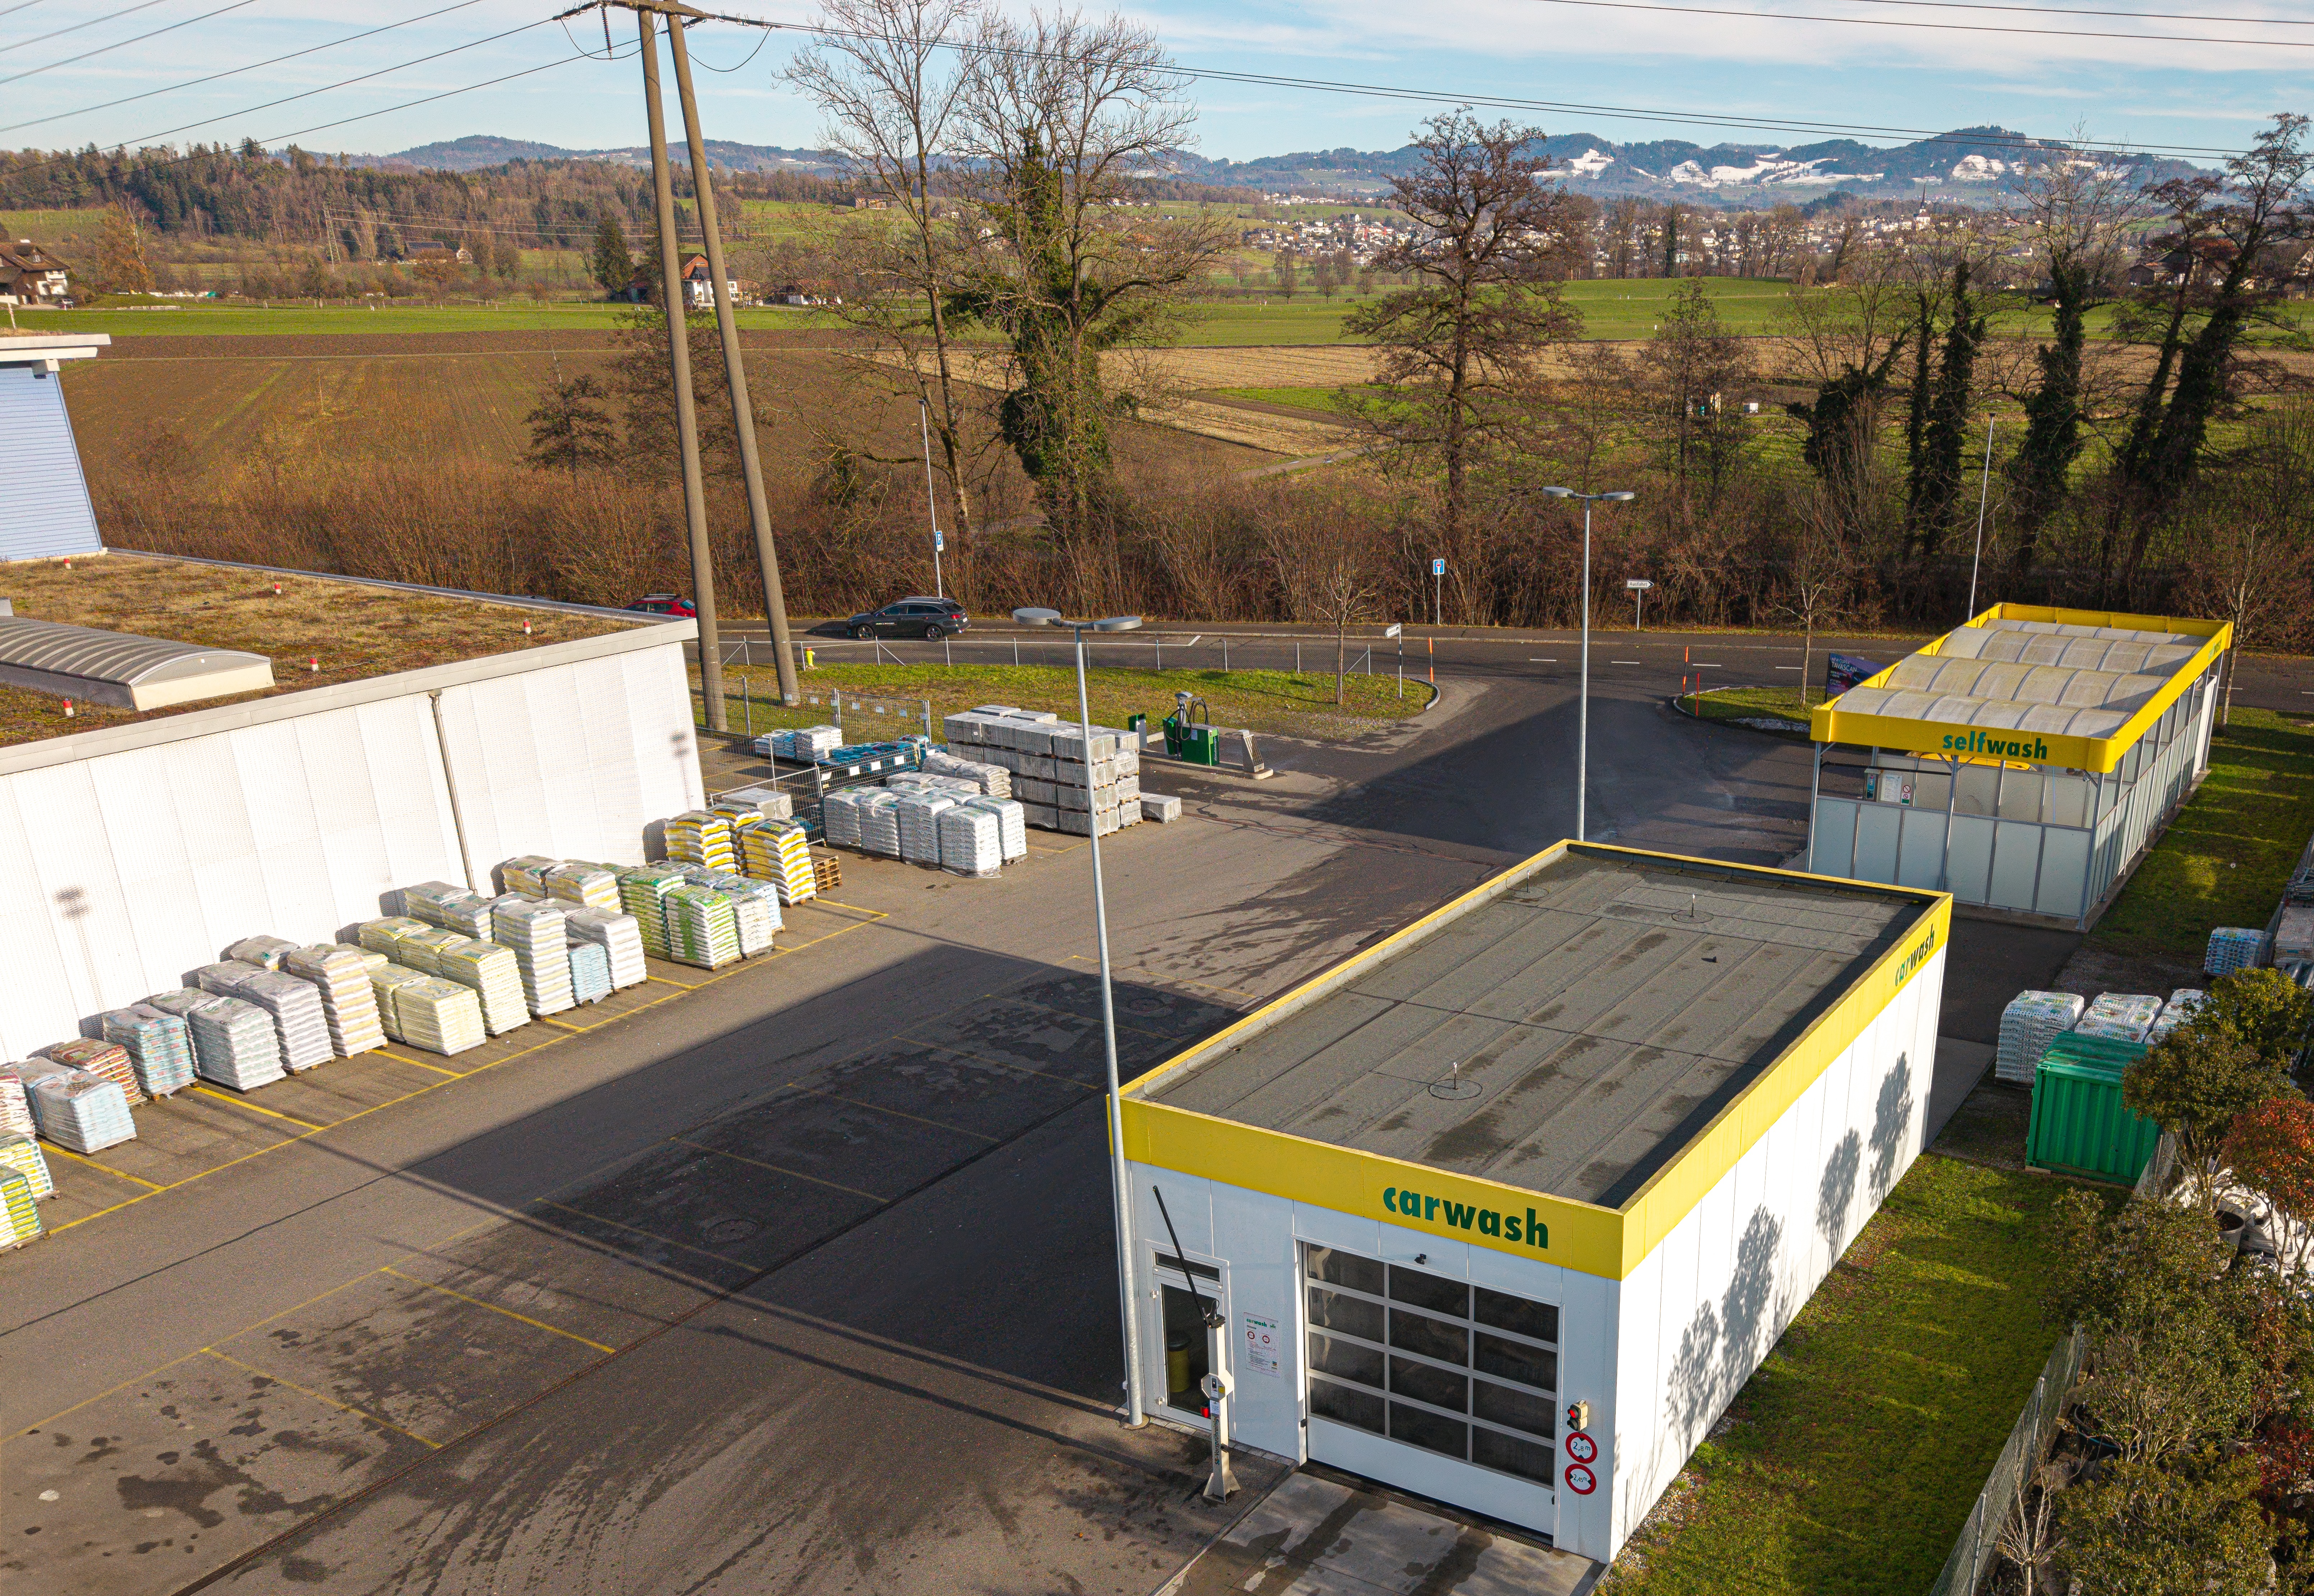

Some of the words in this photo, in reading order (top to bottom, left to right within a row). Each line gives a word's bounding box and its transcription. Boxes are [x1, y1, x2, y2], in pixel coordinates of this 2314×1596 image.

[937, 534, 941, 544] P
[1832, 662, 1857, 672] TAVASCAN
[1943, 731, 2048, 760] selfwash
[1895, 923, 1934, 987] carwash
[1383, 1187, 1548, 1249] carwash
